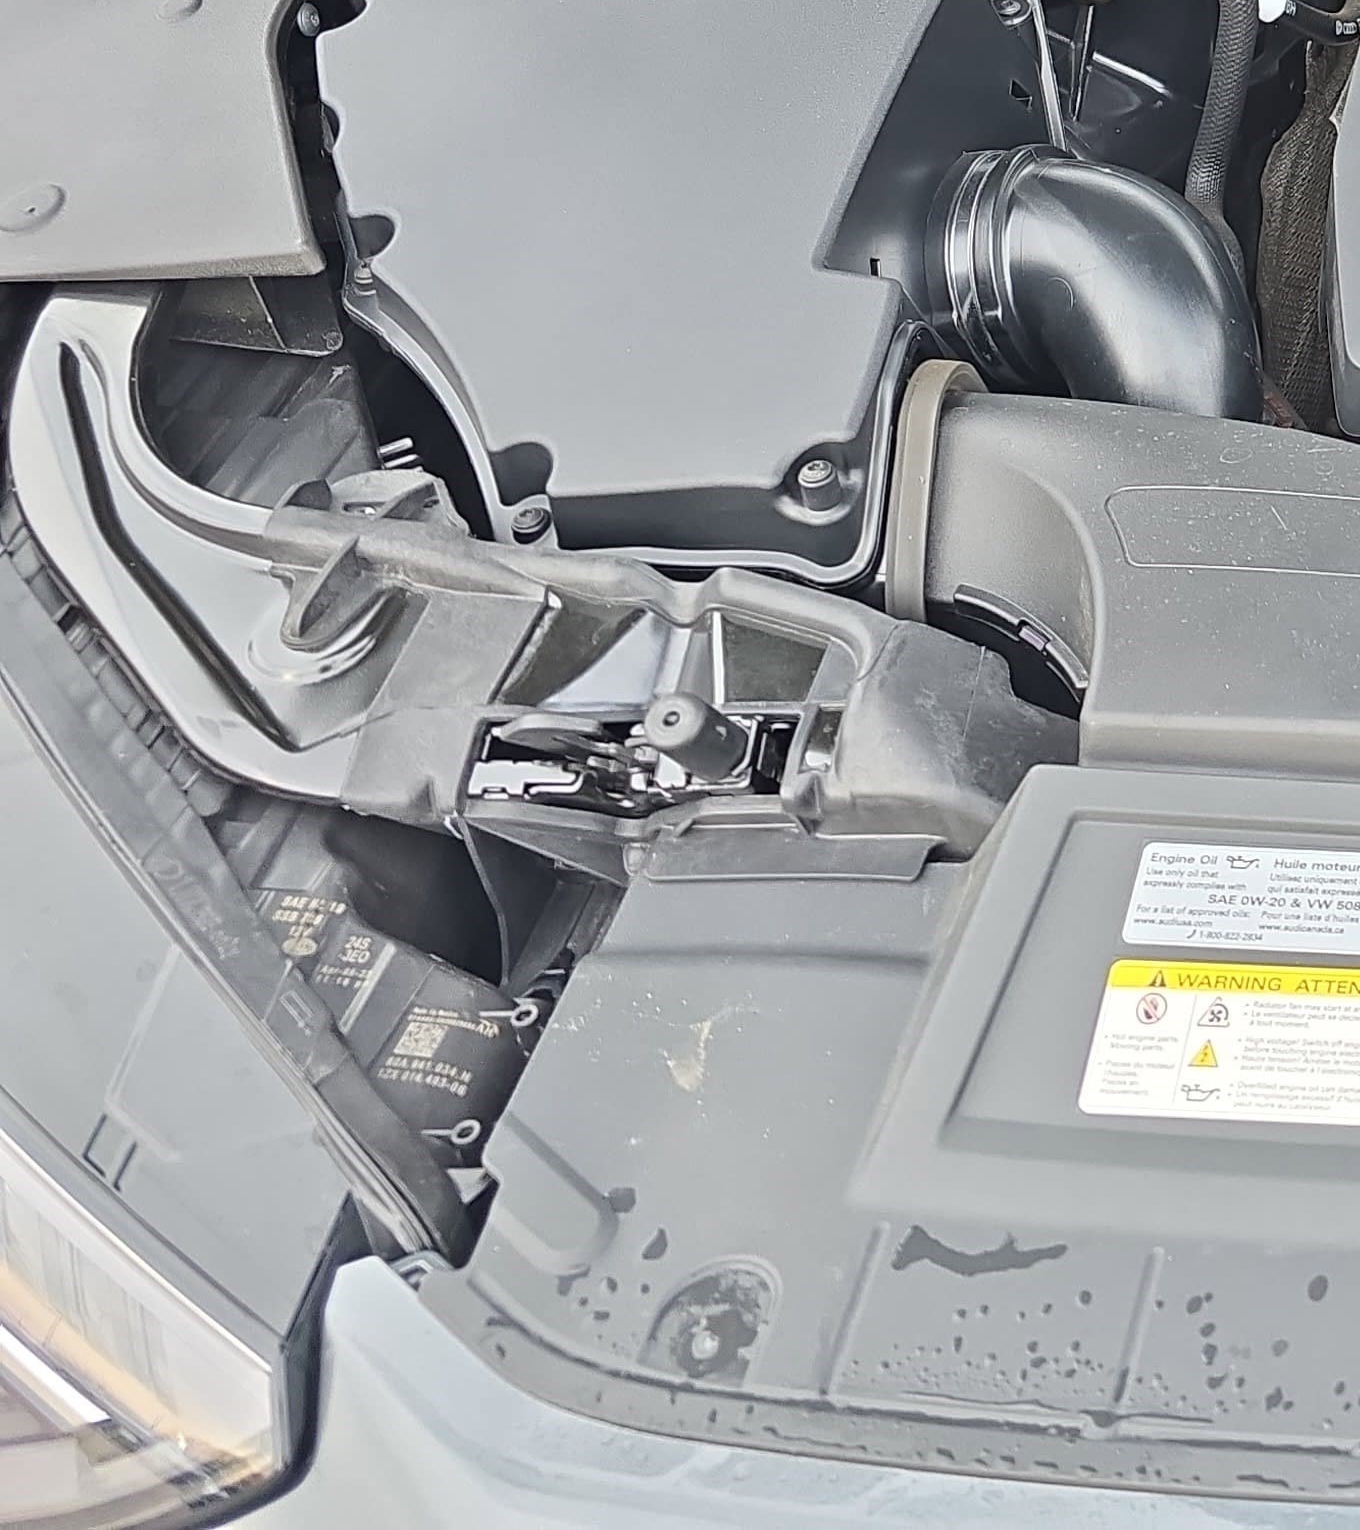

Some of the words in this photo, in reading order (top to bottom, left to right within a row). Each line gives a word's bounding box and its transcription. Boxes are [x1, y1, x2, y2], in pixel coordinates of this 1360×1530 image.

[1151, 852, 1195, 864] Engine
[1200, 855, 1218, 865] Oil
[1273, 858, 1307, 870] Huile
[1166, 870, 1184, 878] only
[1186, 882, 1225, 890] complies
[1304, 876, 1357, 887] uniquement
[1267, 886, 1282, 895] qui
[1284, 887, 1319, 895] satisfait
[281, 896, 309, 909] SAE
[1208, 894, 1237, 905] SAE
[1241, 897, 1286, 907] 0W-20
[1290, 898, 1301, 908] &
[1307, 899, 1332, 909] VW
[1137, 905, 1151, 913] For
[1161, 906, 1174, 914] list
[1188, 909, 1230, 918] approved
[1261, 911, 1282, 921] Pour
[1304, 912, 1322, 922] liste
[1134, 919, 1213, 927] www.audiusa.com
[1259, 924, 1344, 934] www.audicanada.ca
[345, 936, 372, 950] 24S
[1178, 974, 1282, 992] WARNING
